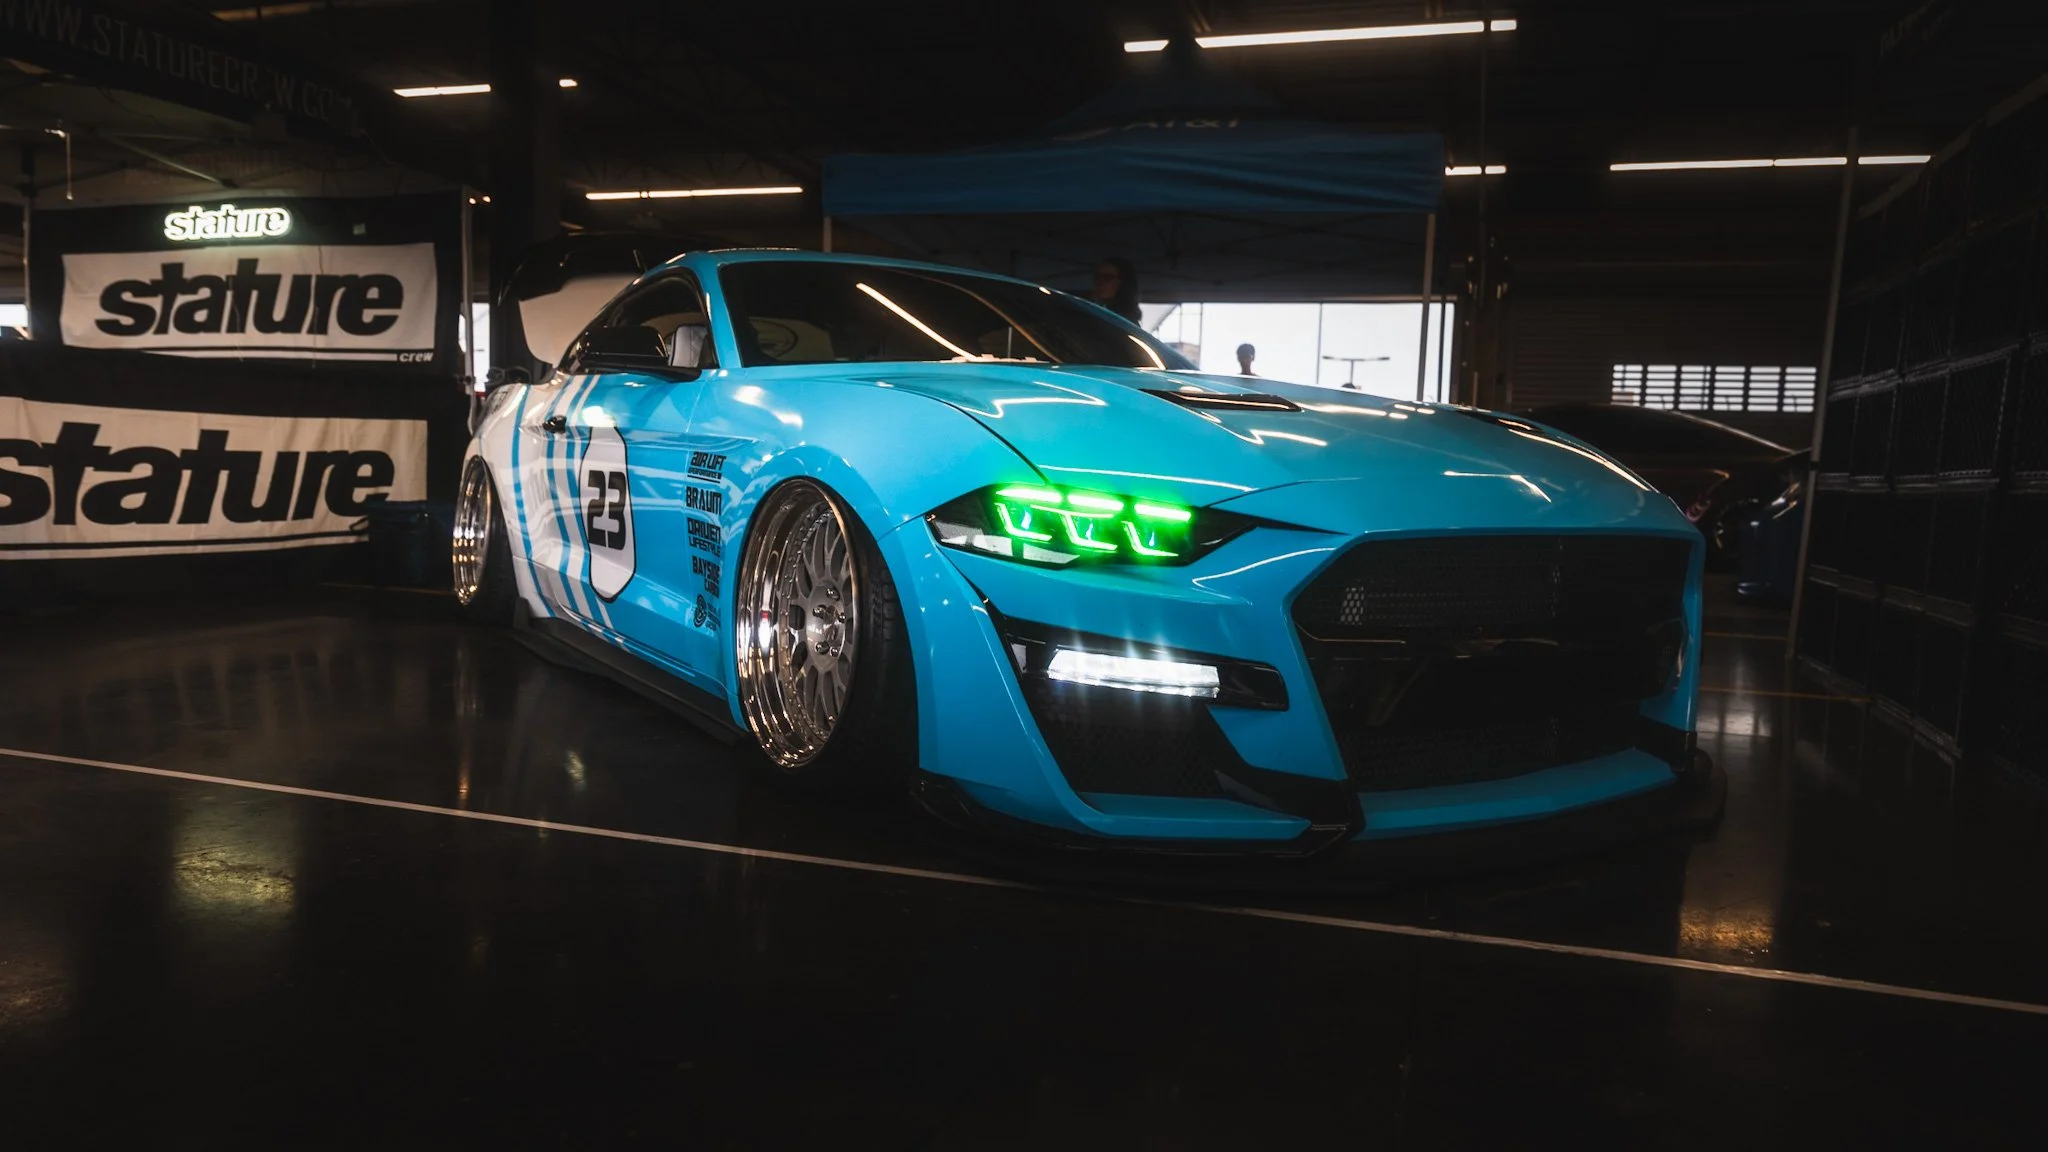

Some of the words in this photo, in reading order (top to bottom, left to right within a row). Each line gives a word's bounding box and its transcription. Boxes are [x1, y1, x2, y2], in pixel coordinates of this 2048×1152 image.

[164, 203, 291, 241] stature
[95, 258, 404, 336] stature
[399, 351, 434, 363] crew
[0, 421, 394, 525] stature
[587, 469, 627, 551] 23
